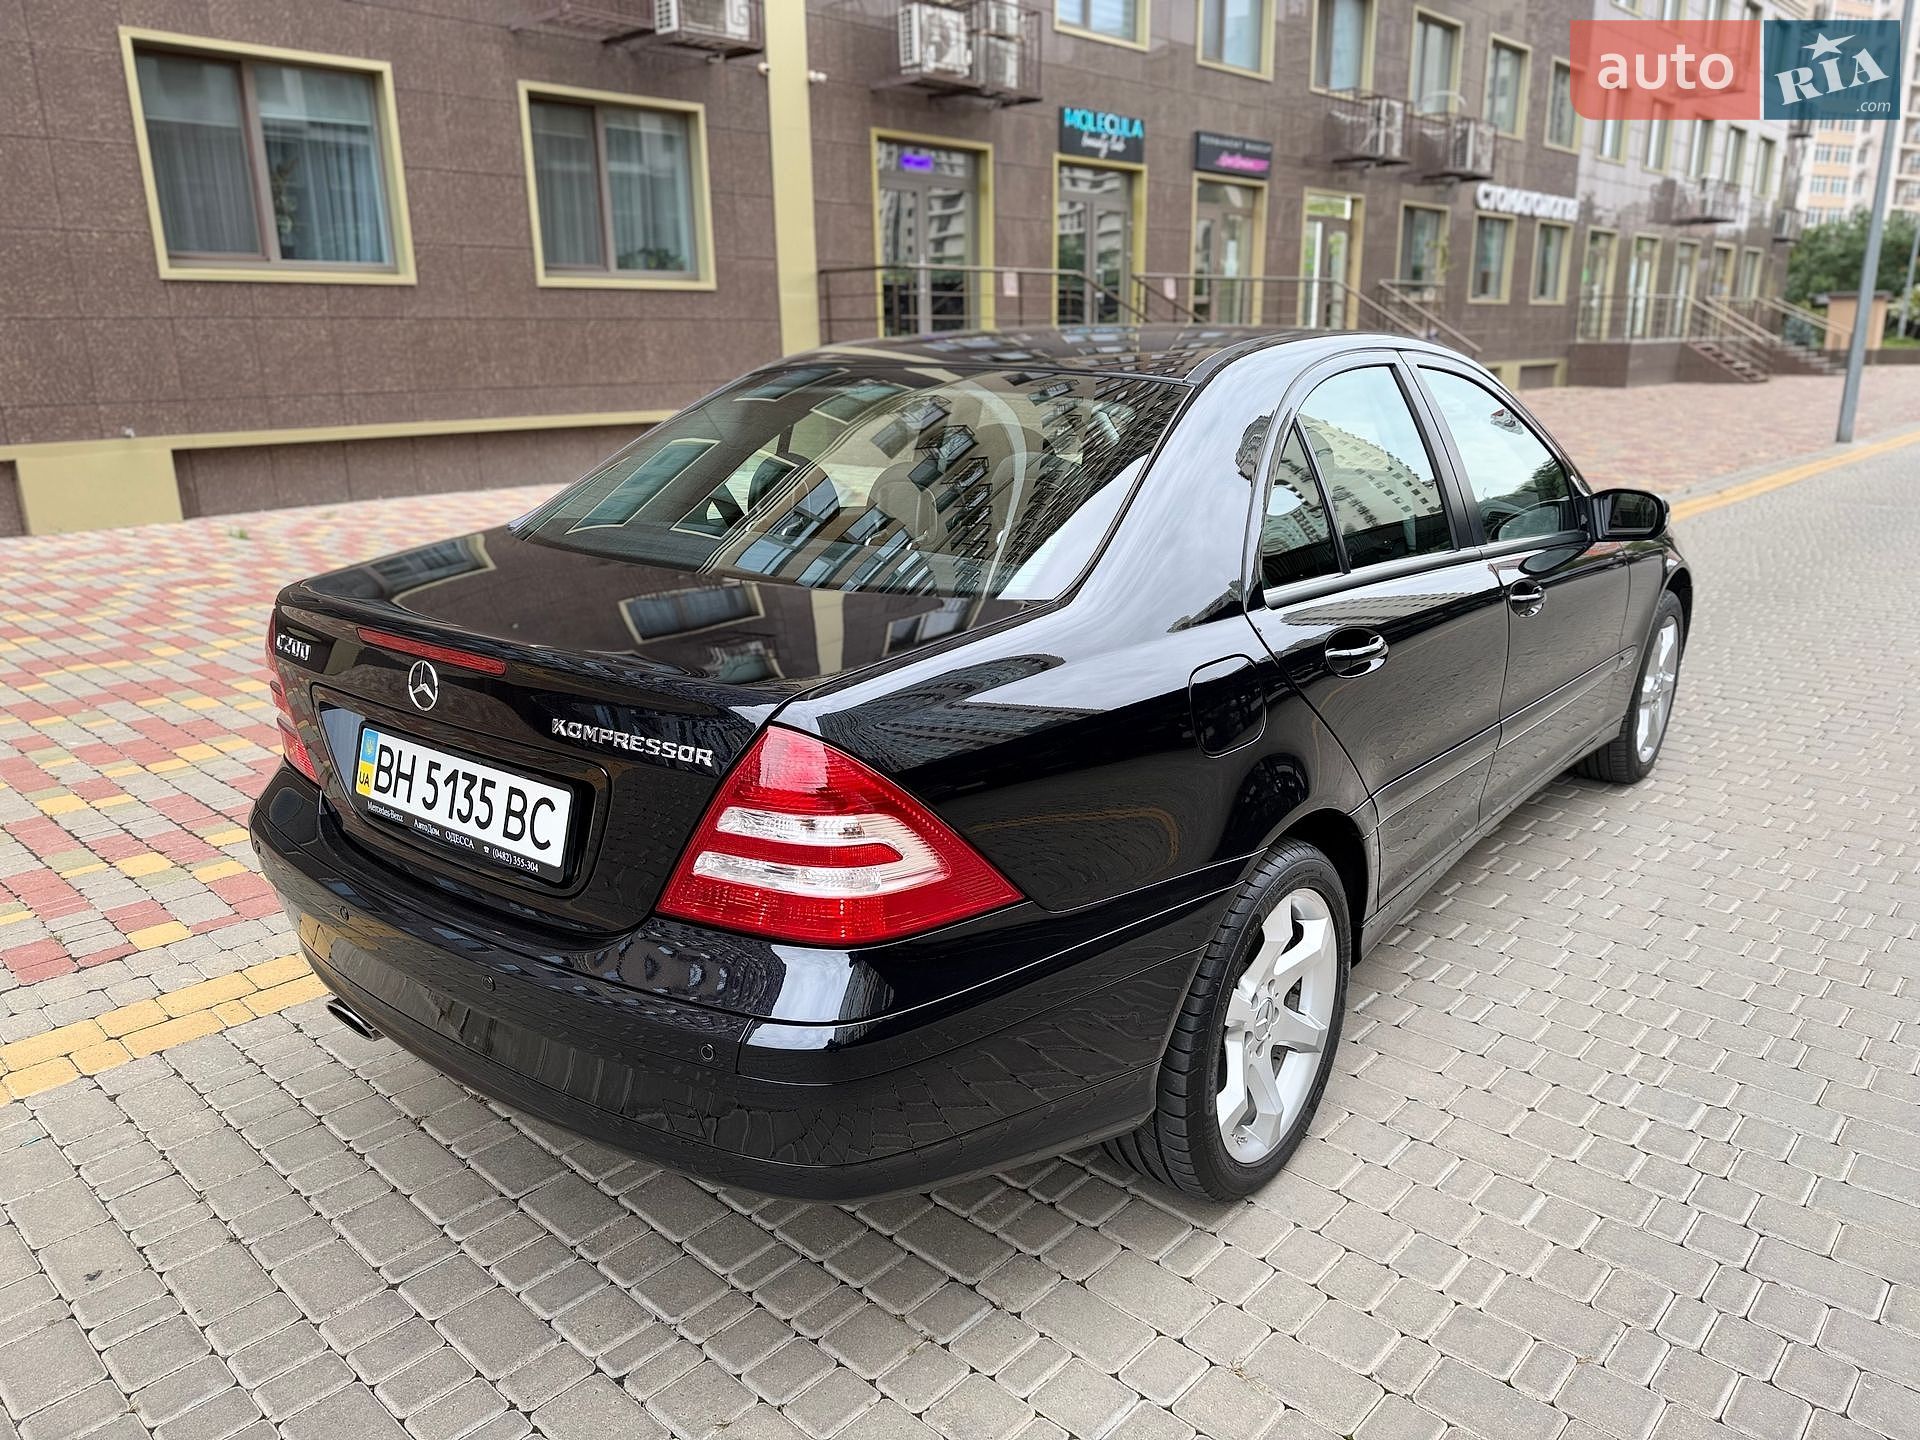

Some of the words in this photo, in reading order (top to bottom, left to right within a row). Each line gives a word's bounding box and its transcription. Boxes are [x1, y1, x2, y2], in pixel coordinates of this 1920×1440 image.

[552, 718, 713, 767] KOMPRESSOR
[359, 771, 370, 787] UA
[374, 743, 417, 804] BH
[422, 760, 497, 831] 5135
[502, 785, 556, 851] BC
[445, 830, 475, 850] ОДЕССА
[492, 847, 513, 865] (0482)
[512, 855, 539, 873] 355-304
